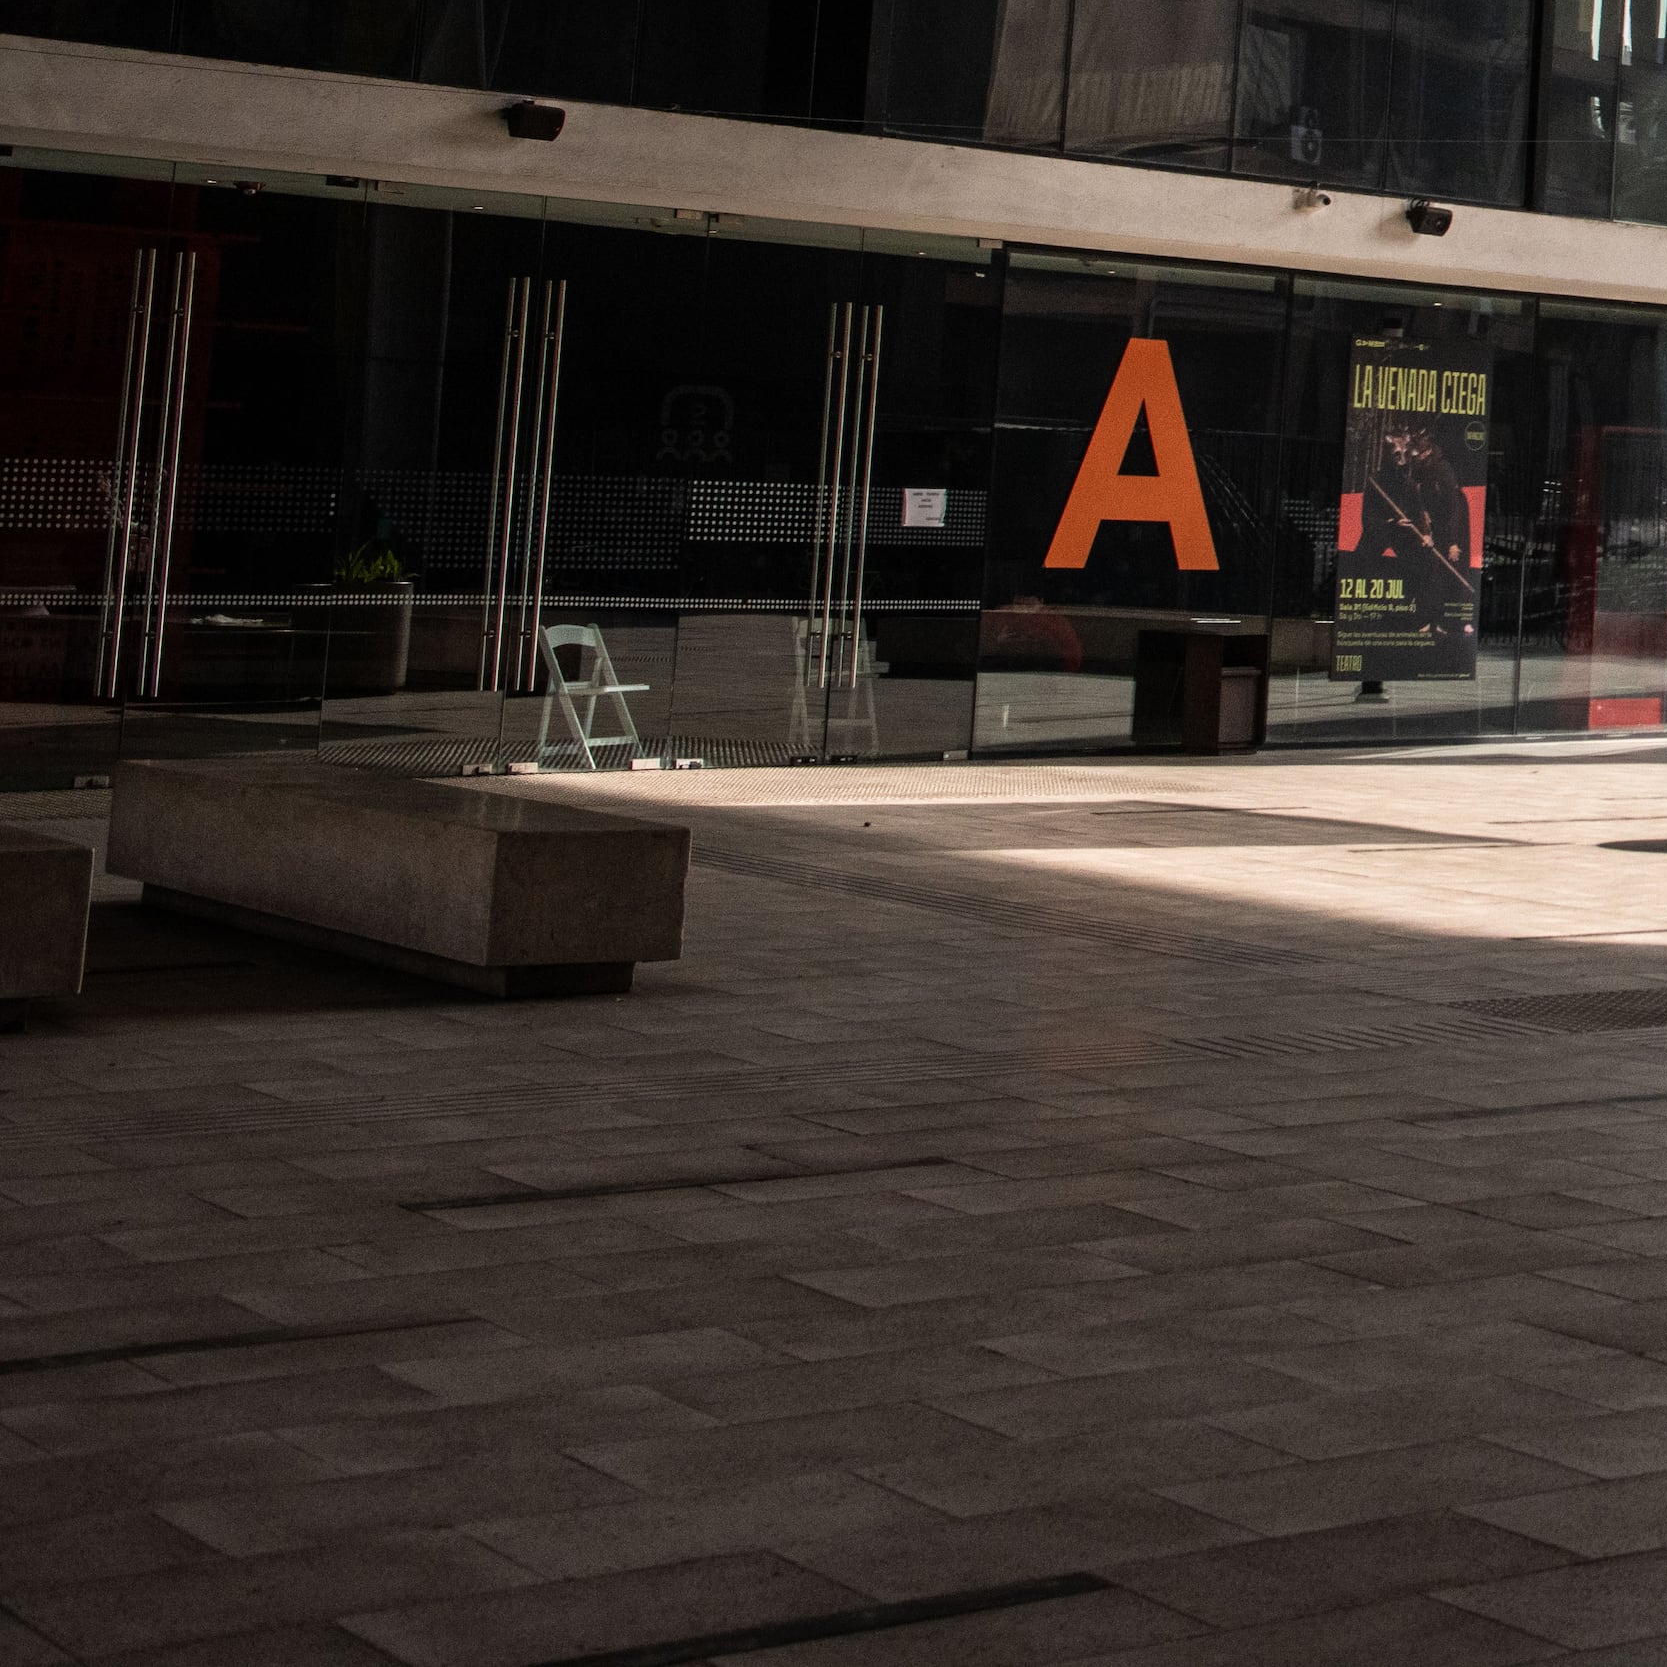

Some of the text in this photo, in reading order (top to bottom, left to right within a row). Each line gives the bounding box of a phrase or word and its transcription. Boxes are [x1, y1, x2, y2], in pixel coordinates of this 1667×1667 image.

[1353, 364, 1486, 416] LA VENADA CIEGA
[1043, 337, 1220, 570] A
[1339, 578, 1405, 599] 12 AL 20 JUL
[1339, 603, 1354, 612] Sala
[1362, 603, 1388, 613] (Edificio
[1395, 604, 1408, 613] piso
[1336, 654, 1362, 672] TEATRO
